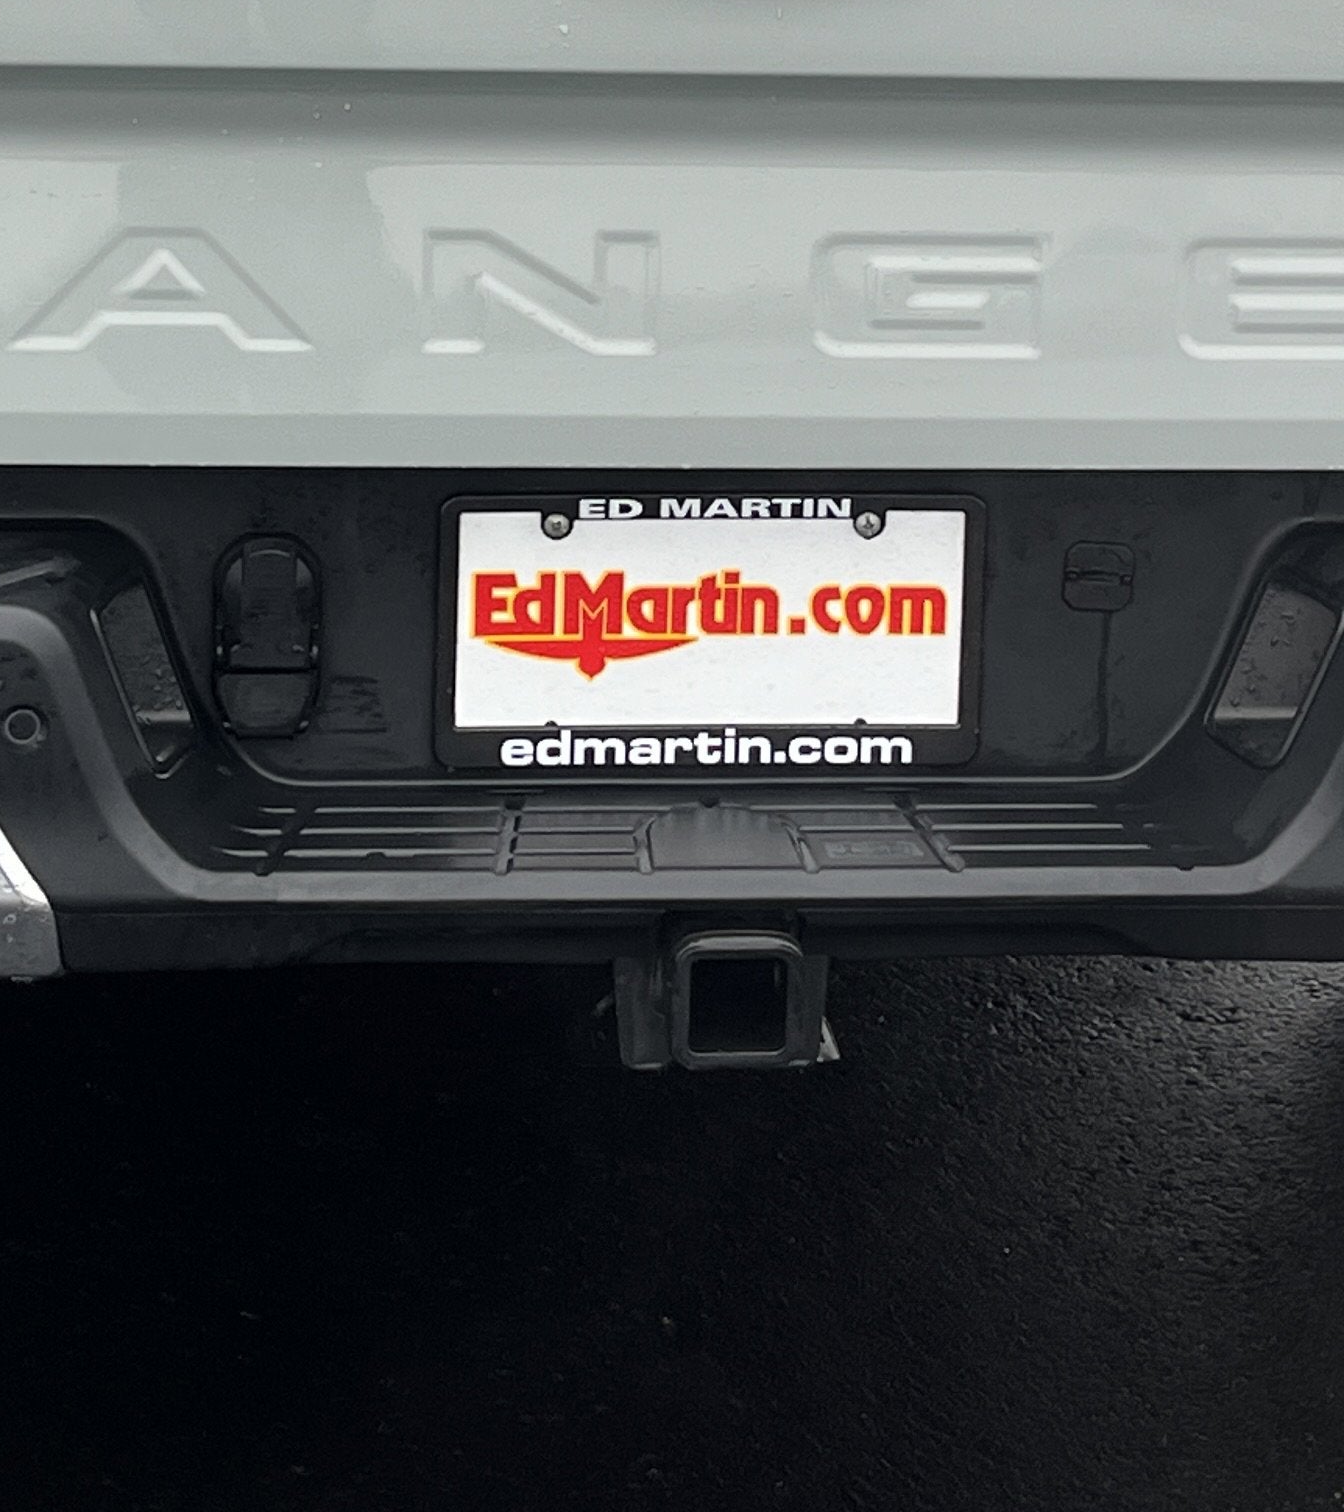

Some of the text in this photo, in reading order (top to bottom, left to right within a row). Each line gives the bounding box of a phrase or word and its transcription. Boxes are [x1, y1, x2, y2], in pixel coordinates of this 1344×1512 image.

[577, 497, 853, 520] ED MARTIN
[471, 568, 947, 638] EdMartin.com
[500, 728, 913, 767] edmartin.com
